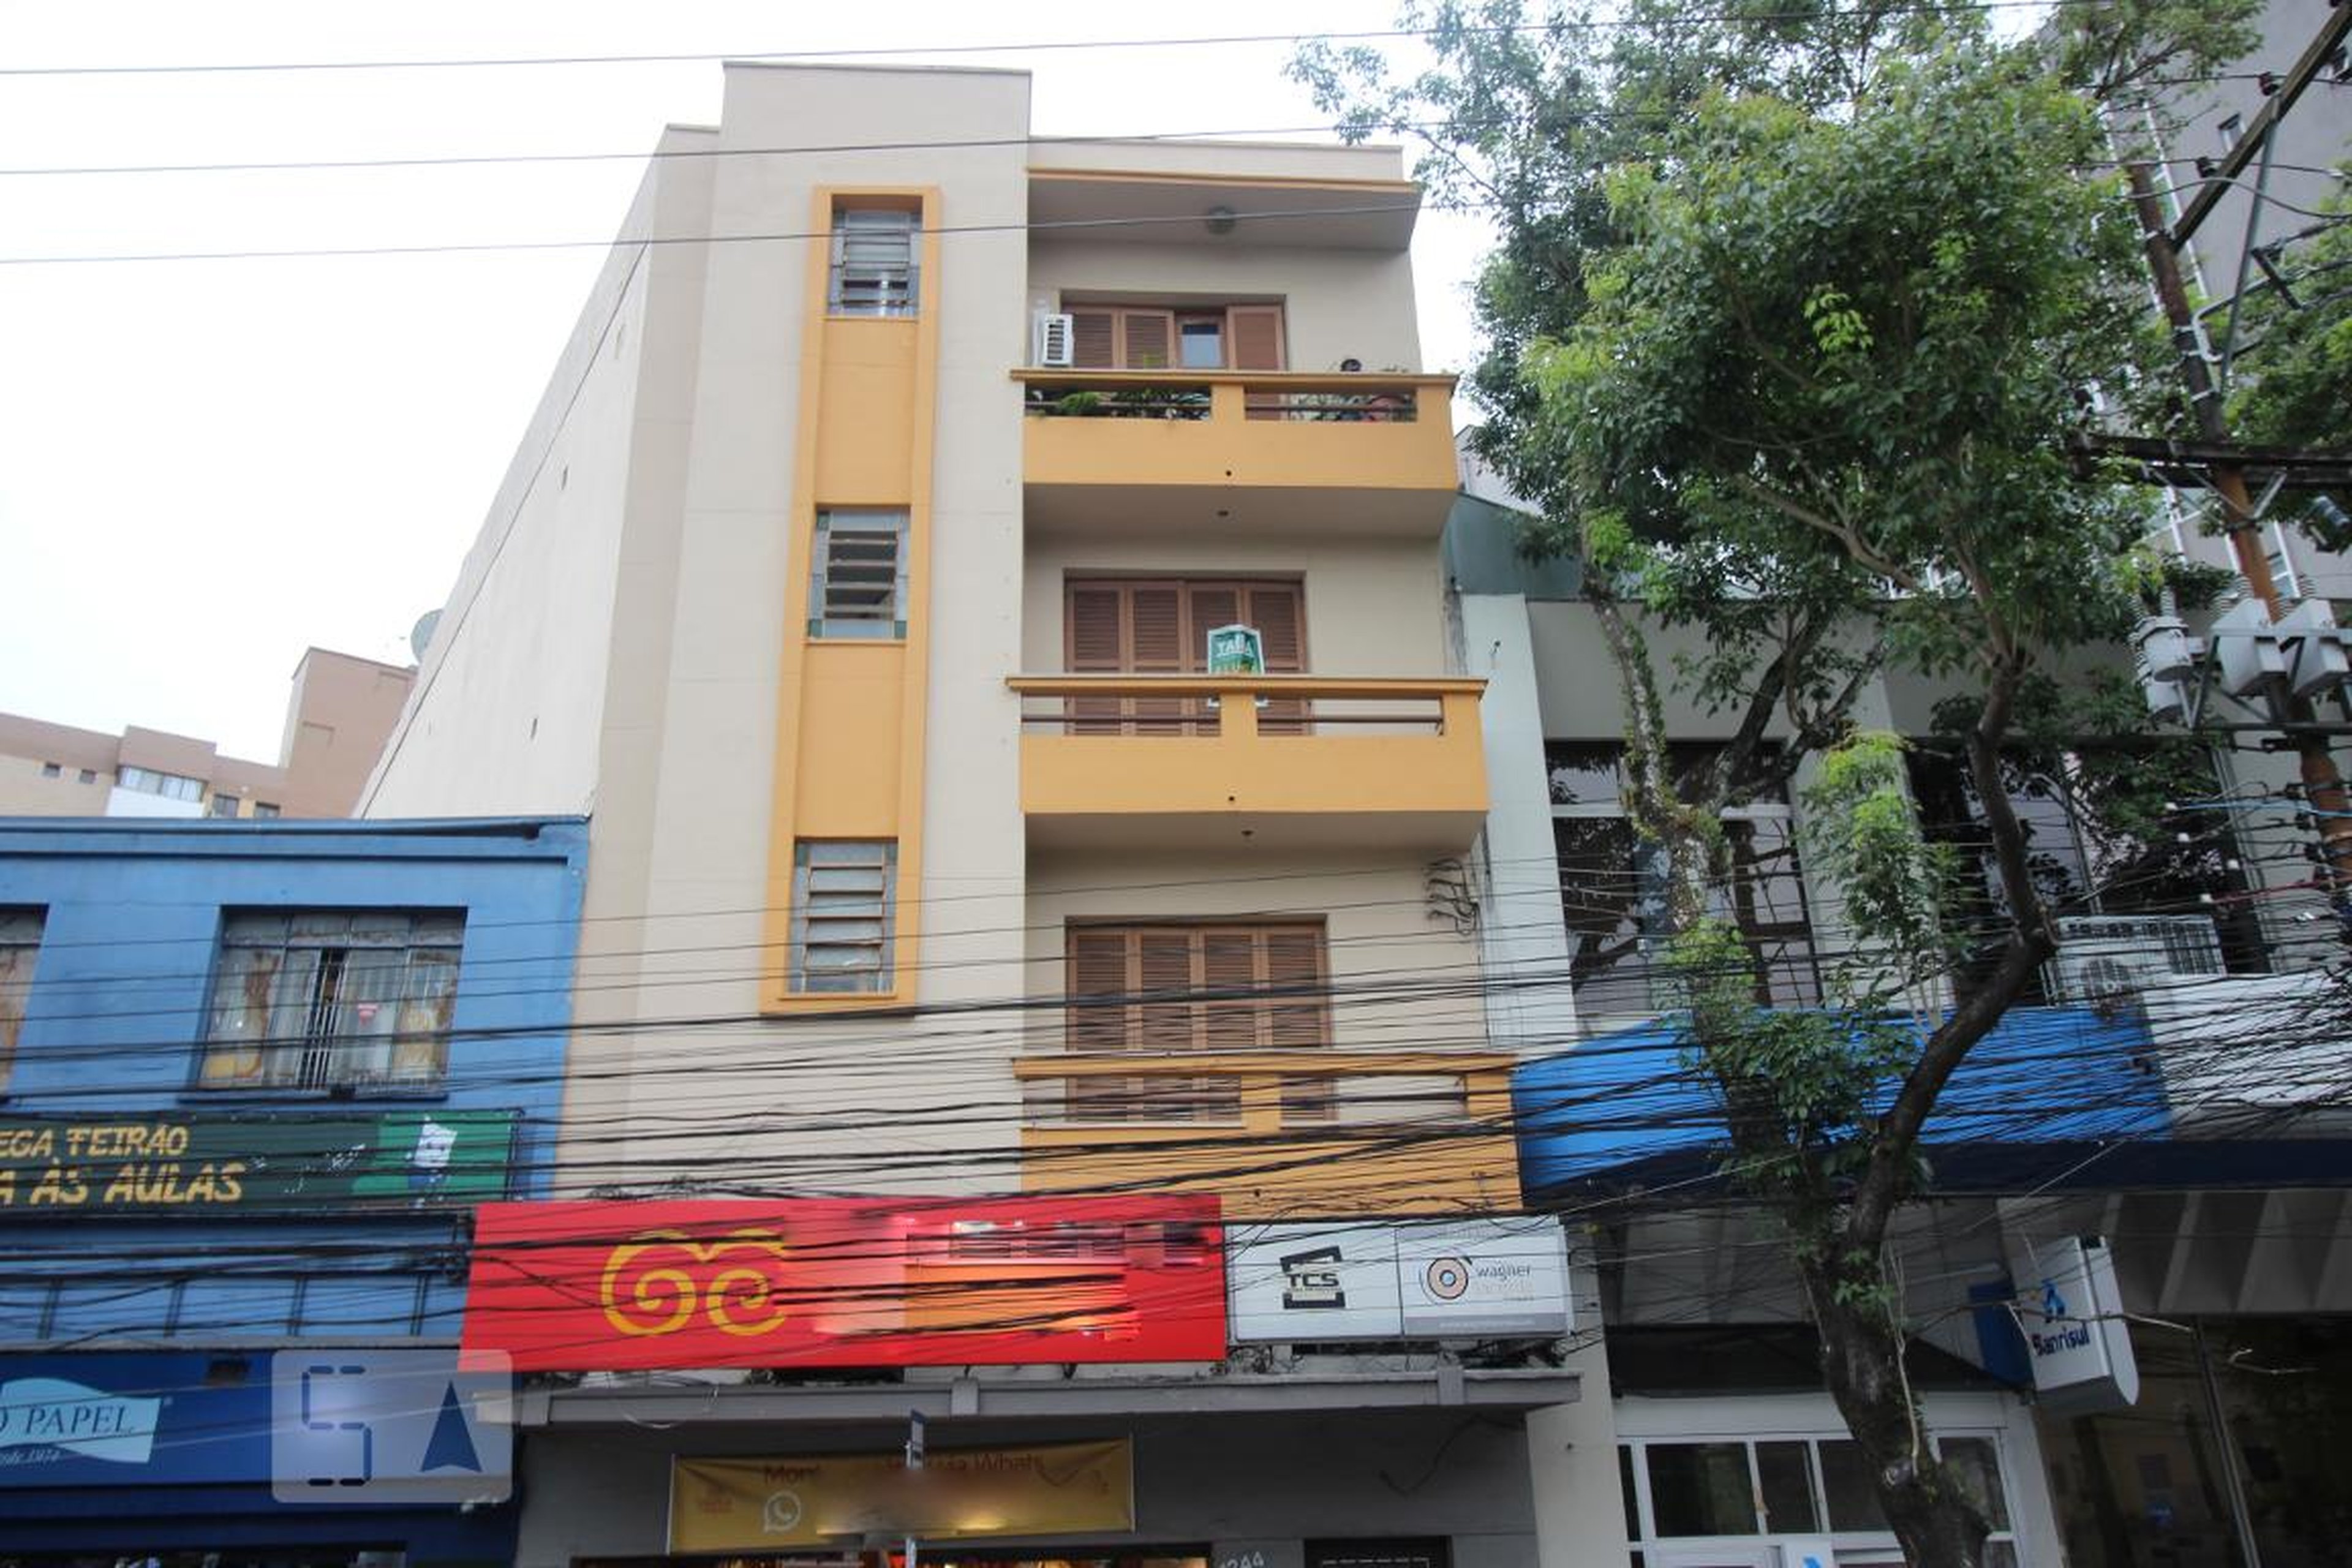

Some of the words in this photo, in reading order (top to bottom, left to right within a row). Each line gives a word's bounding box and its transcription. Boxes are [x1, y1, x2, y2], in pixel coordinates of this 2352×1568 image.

[103, 1162, 246, 1204] AULAS
[1286, 1272, 1340, 1287] TCS
[1475, 1264, 1531, 1281] wagner
